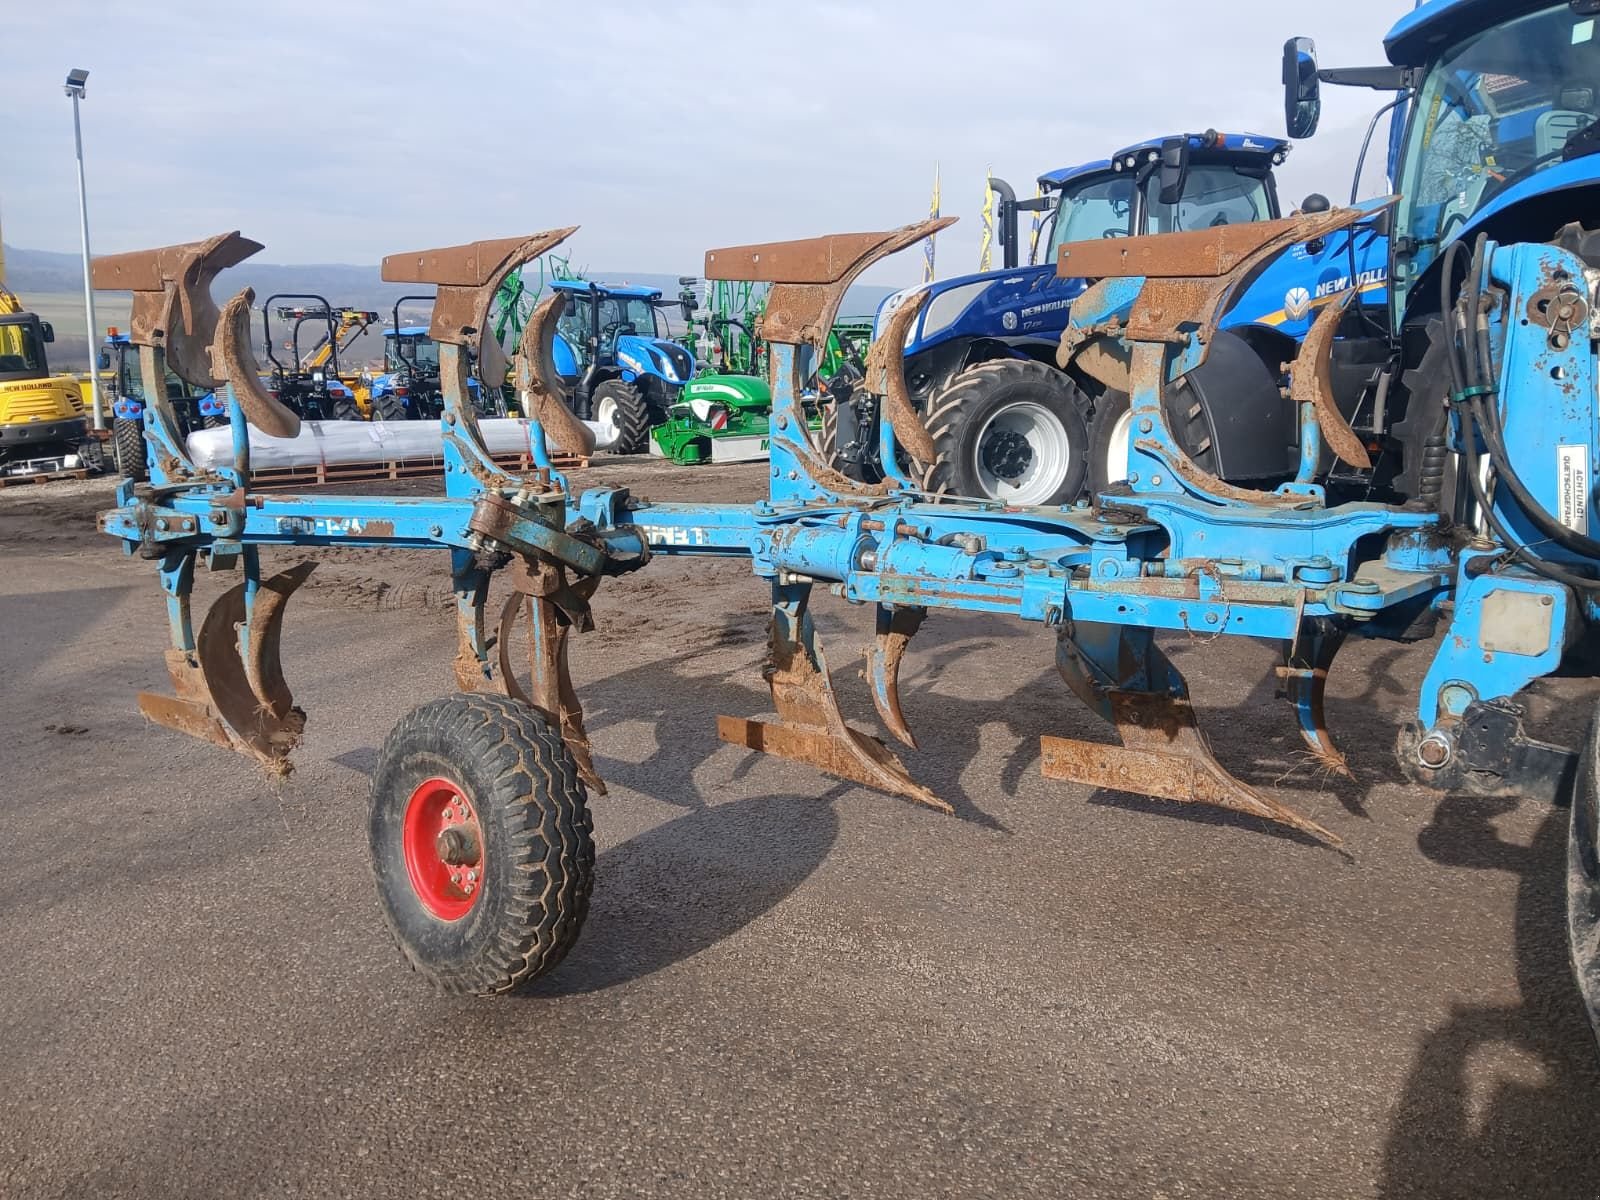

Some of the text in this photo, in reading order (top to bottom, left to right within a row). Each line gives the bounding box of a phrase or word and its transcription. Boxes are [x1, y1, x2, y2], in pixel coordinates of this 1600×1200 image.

[1315, 276, 1348, 298] NEW
[1021, 305, 1041, 319] NEW
[4, 382, 53, 393] NEW HOLLAND
[1576, 469, 1585, 519] ACHTUNG!
